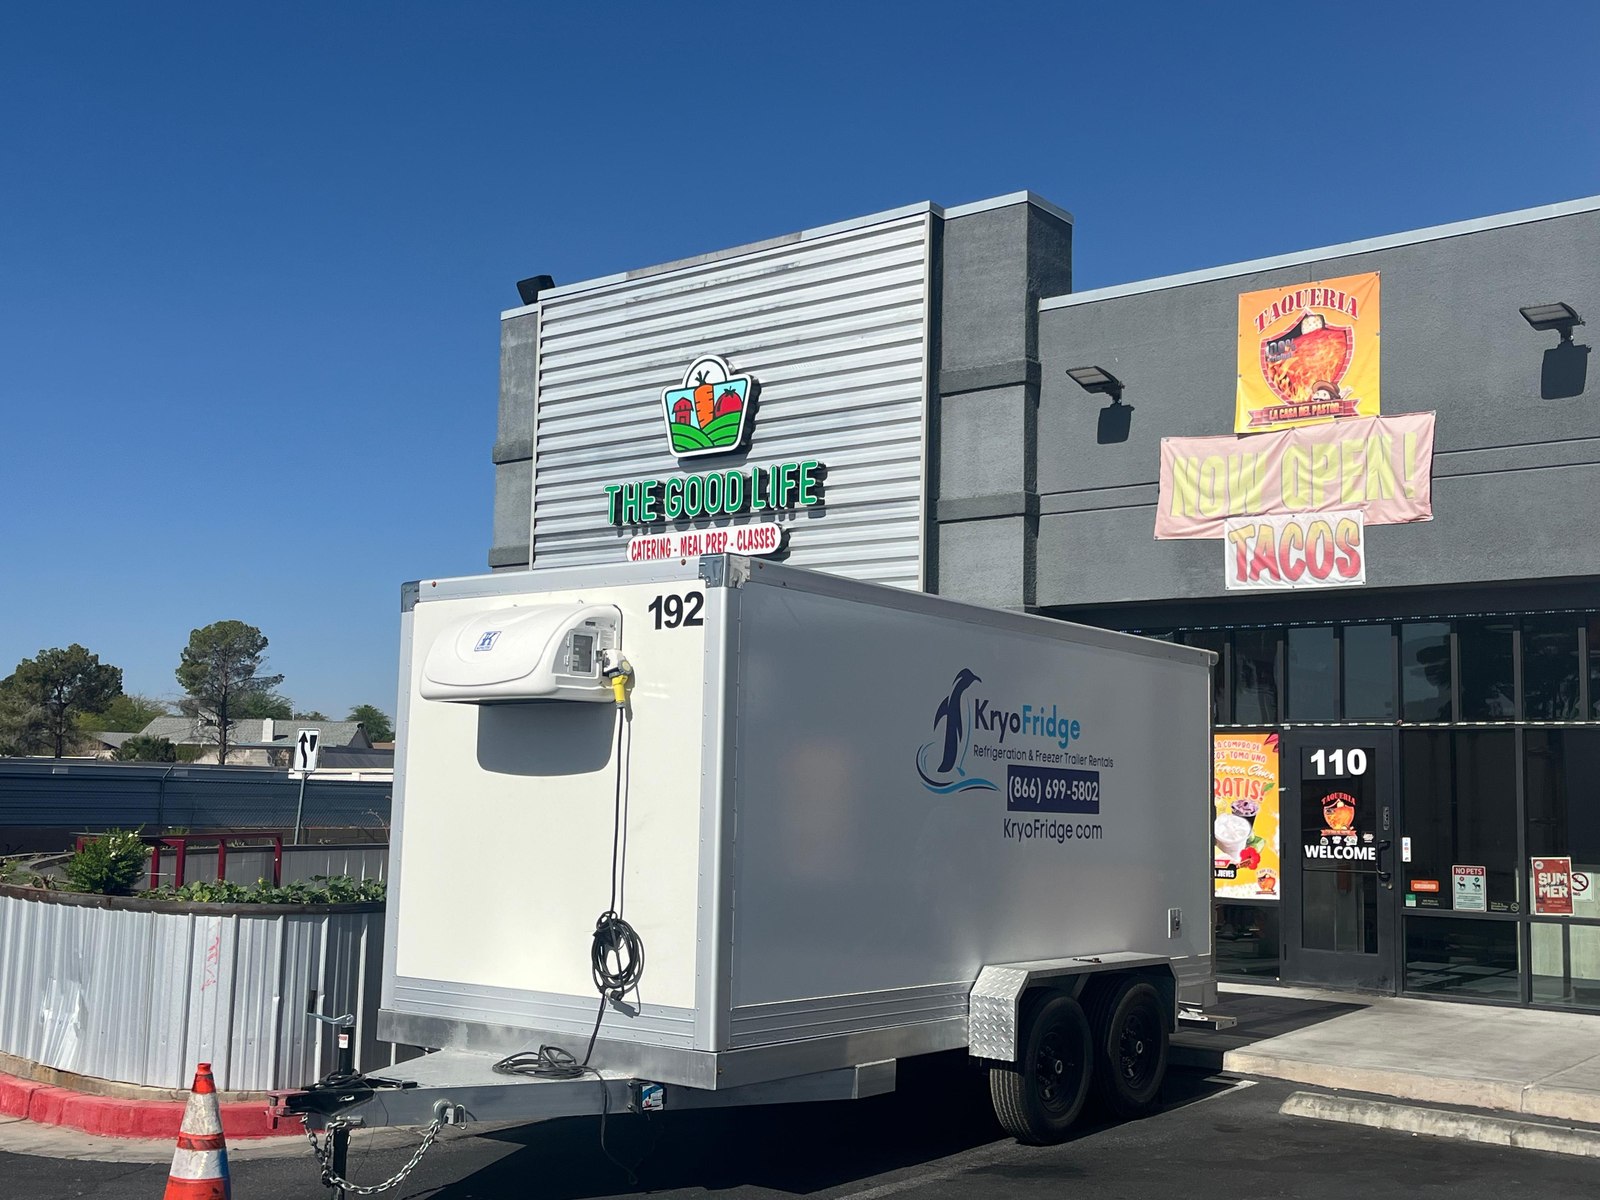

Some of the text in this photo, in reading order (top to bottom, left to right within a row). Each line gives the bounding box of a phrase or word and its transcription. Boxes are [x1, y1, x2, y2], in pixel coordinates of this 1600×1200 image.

[1254, 288, 1359, 332] TAQUERIA
[1269, 408, 1279, 420] LA
[1280, 405, 1297, 419] CASA
[1298, 404, 1311, 417] DEL
[604, 460, 819, 525] THE GOOD LIFE
[1171, 451, 1268, 518] NOW
[631, 536, 672, 561] CATERING
[680, 534, 703, 557] MEAL
[705, 531, 727, 554] PREP
[737, 527, 776, 551] CLASSES
[1228, 518, 1361, 582] TACOS
[648, 591, 704, 630] 192
[974, 698, 1081, 749] KryoFridge
[974, 744, 1114, 768] Refrigeration & Freezer Trailer Rentals
[1310, 748, 1367, 775] 110
[1009, 775, 1099, 804] (866) 699-5802
[1214, 777, 1267, 802] RATIS!
[1003, 818, 1103, 844] KryoFridge.com
[1304, 845, 1376, 860] WELCOME
[1455, 867, 1465, 875] NO
[1538, 872, 1567, 886] SUM
[1538, 886, 1568, 898] MER
